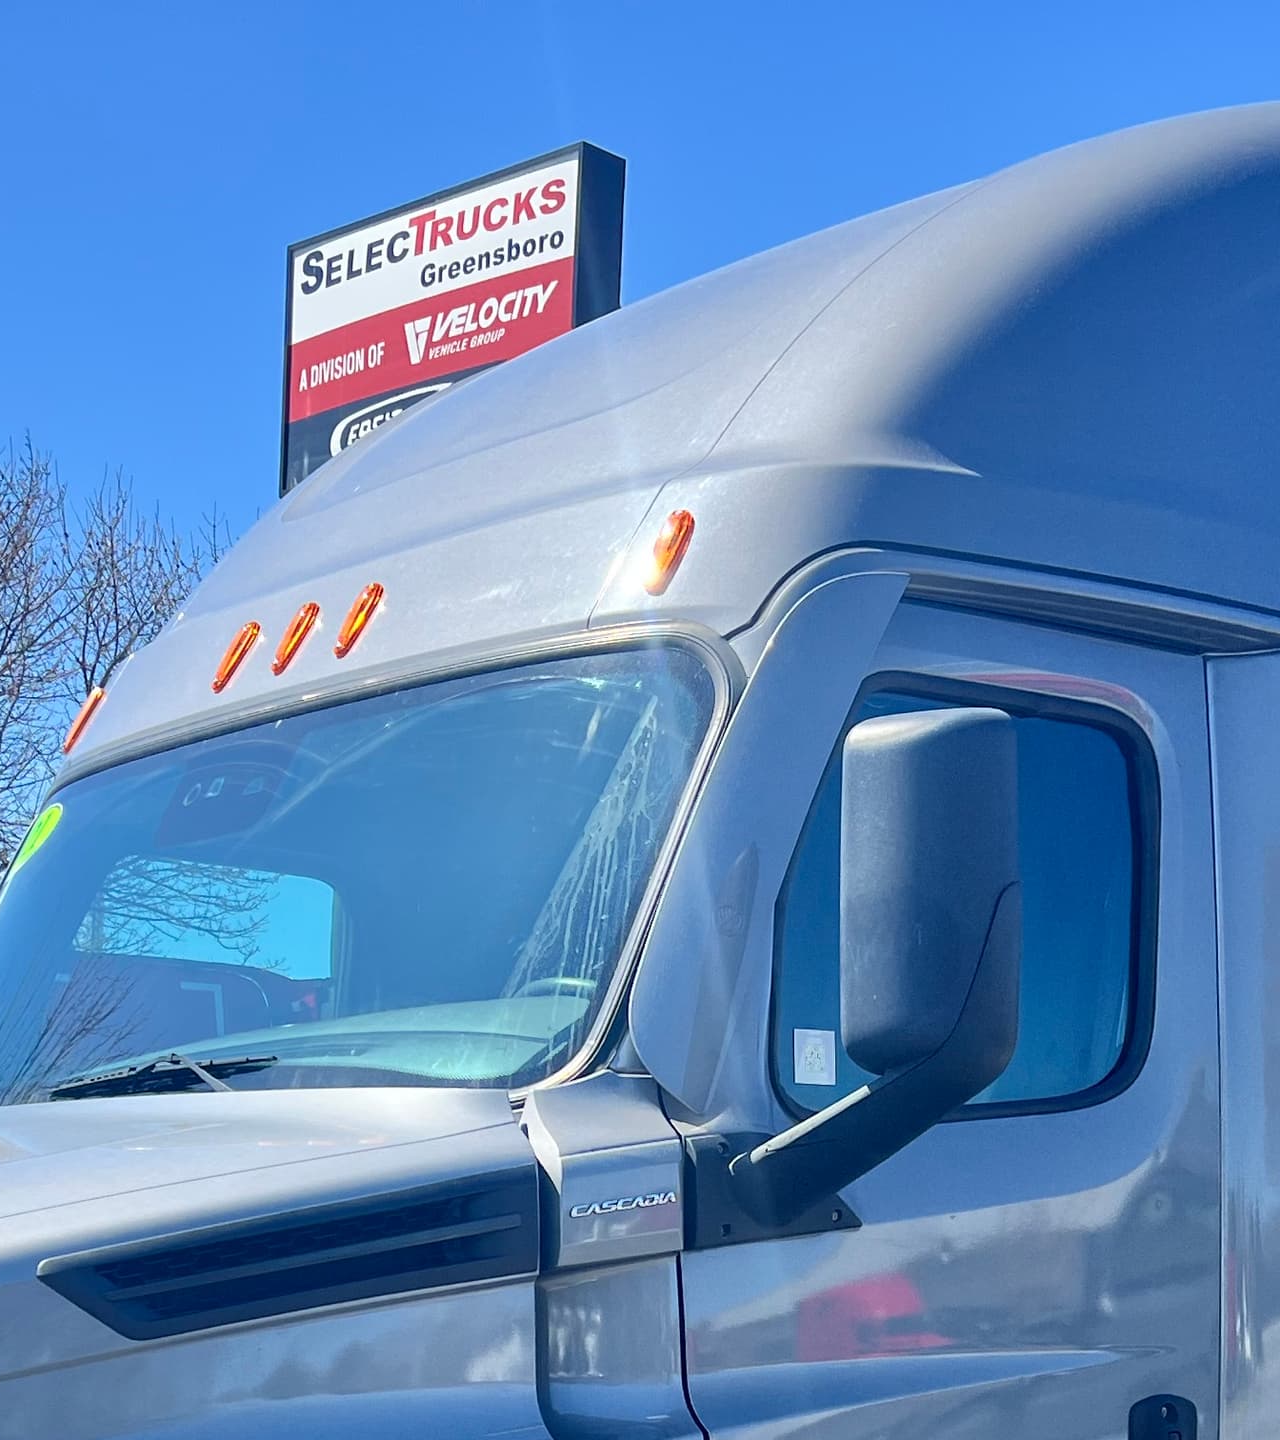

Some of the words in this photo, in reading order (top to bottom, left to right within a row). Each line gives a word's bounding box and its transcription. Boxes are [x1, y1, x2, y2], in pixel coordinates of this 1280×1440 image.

[421, 230, 564, 287] Greensboro
[431, 280, 558, 342] VELOCITY
[298, 368, 309, 392] A
[310, 347, 365, 385] DIVISION
[367, 341, 385, 367] OF
[428, 340, 467, 360] VEHICLE
[469, 328, 505, 349] GROUP
[570, 1191, 677, 1218] CASCADIA
